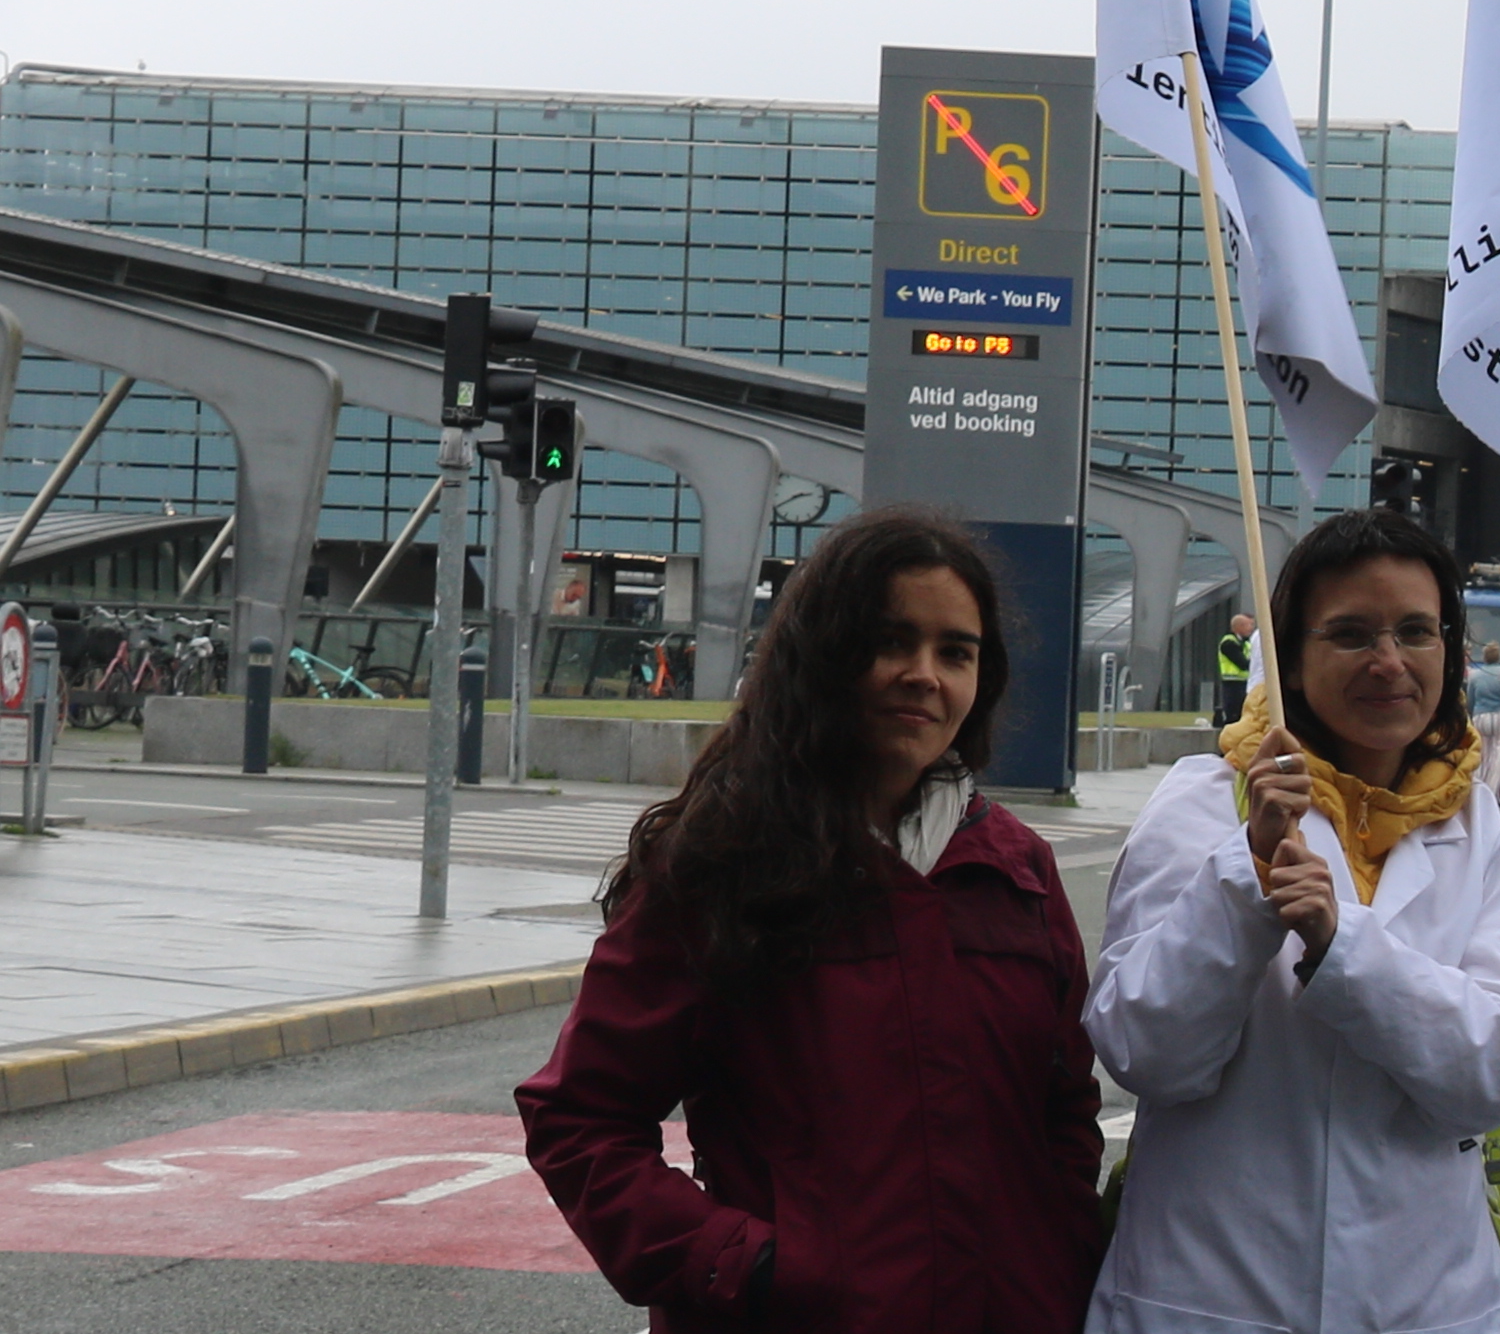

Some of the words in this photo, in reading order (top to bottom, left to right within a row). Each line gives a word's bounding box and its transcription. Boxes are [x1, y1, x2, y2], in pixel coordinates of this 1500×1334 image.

[939, 239, 1020, 265] Direct
[917, 286, 945, 304] We
[948, 287, 987, 306] Park
[1002, 290, 1033, 308] You
[1036, 292, 1061, 313] Fly
[925, 333, 952, 352] Go
[955, 335, 977, 353] to
[909, 385, 955, 408] Altid
[962, 389, 1039, 413] adgang
[909, 412, 949, 432] ved
[954, 412, 1036, 436] booking
